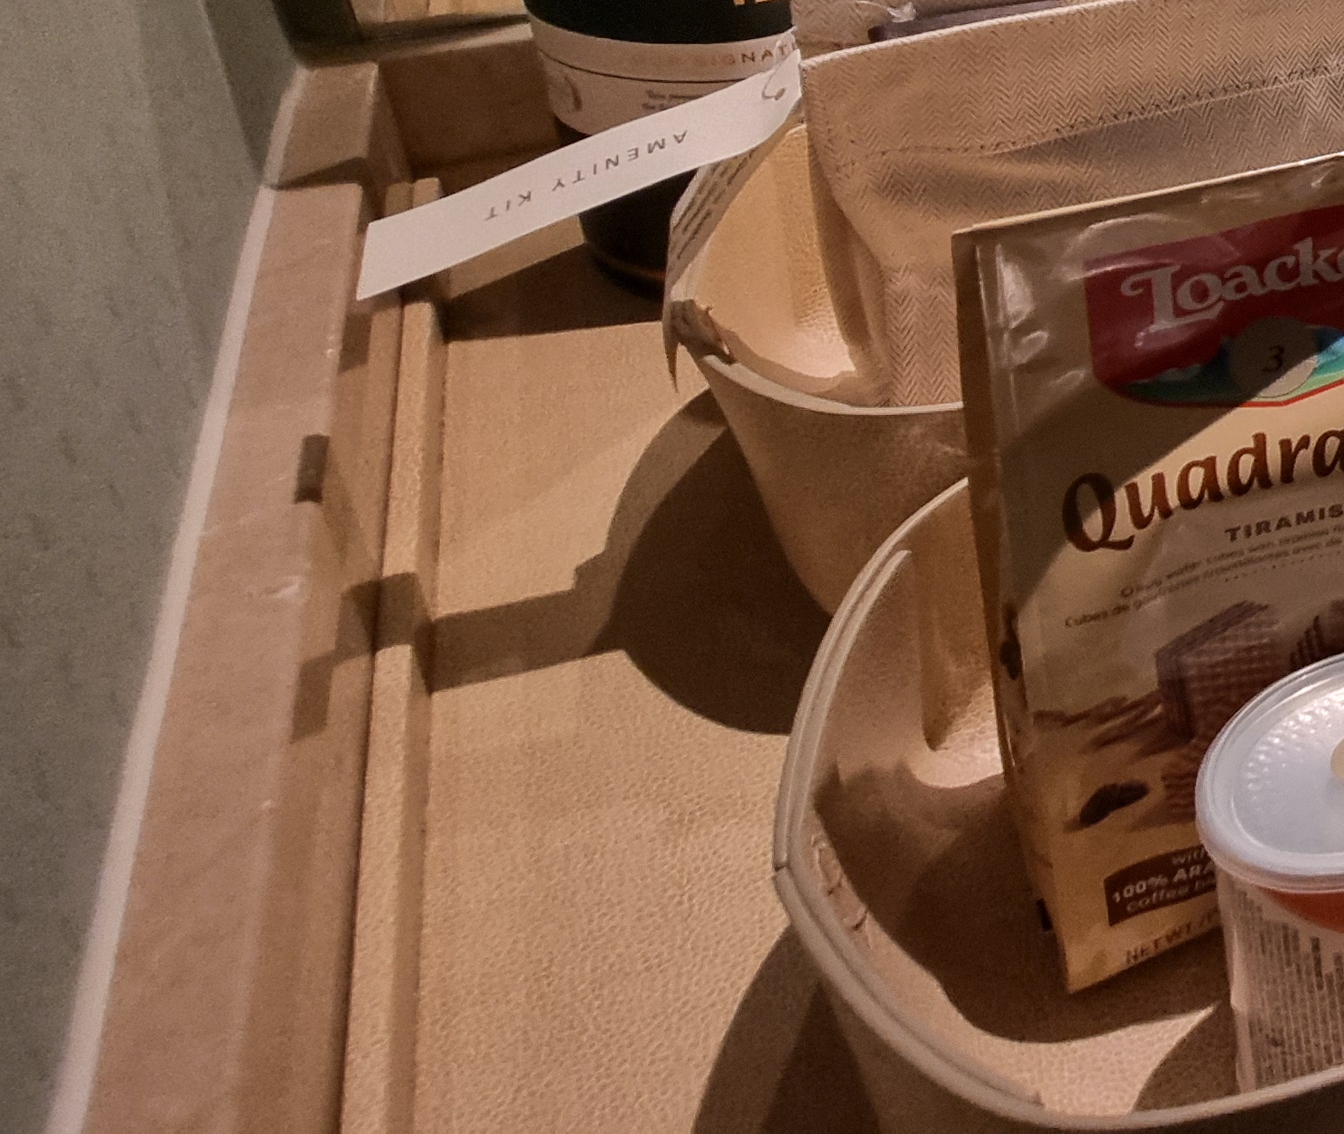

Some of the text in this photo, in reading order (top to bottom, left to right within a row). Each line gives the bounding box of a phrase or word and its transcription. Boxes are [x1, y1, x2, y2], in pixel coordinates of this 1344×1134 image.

[484, 128, 688, 222] AMENITY KIT
[1112, 875, 1168, 903] 100%
